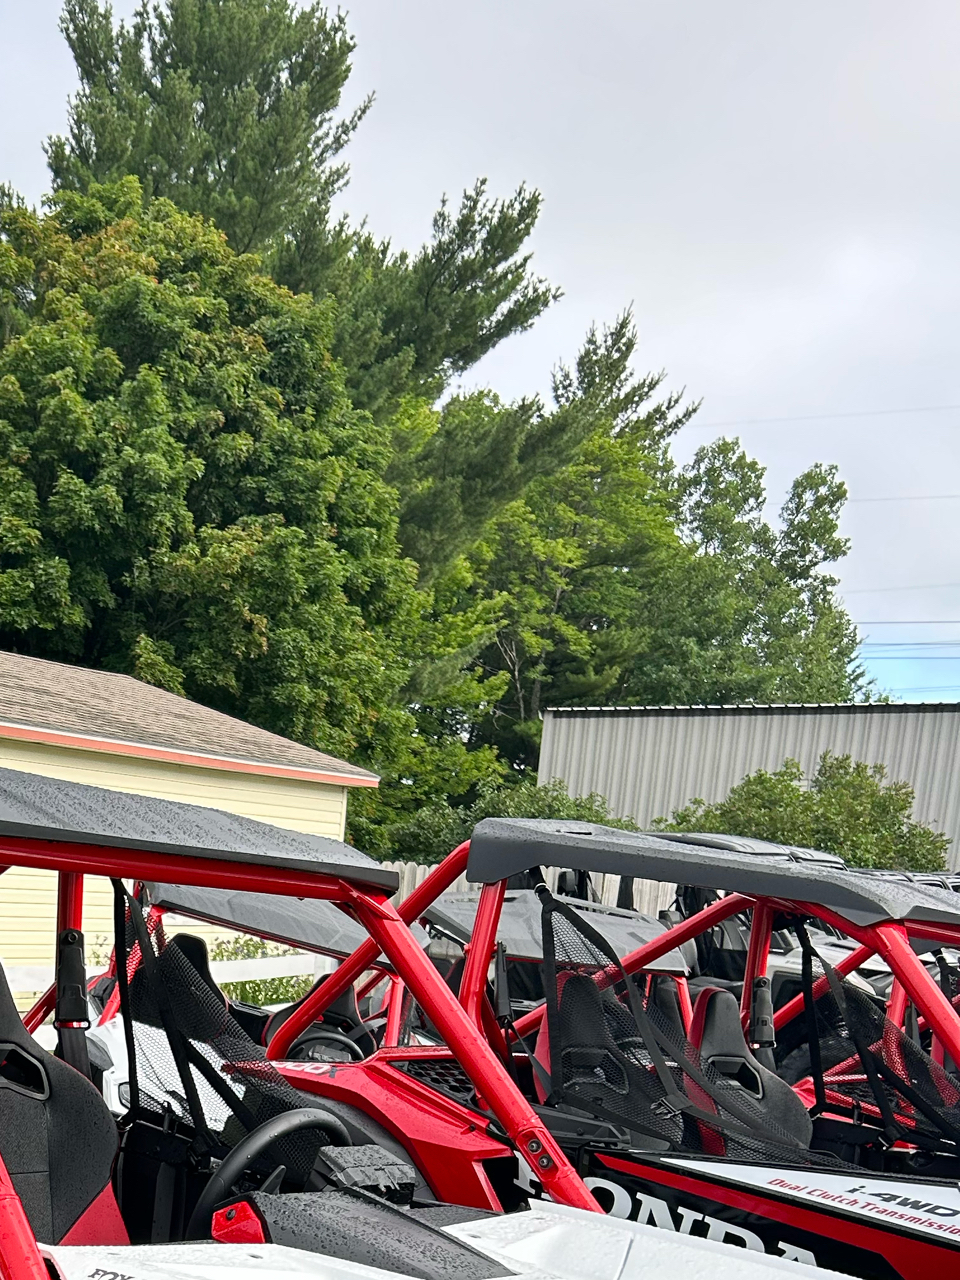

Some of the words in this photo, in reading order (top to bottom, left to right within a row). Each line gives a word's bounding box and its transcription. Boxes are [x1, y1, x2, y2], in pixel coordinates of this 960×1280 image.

[766, 1178, 808, 1193] Dual
[806, 1188, 860, 1207] Clutch
[859, 1201, 960, 1237] Transmissio
[844, 1185, 960, 1218] i-4WD
